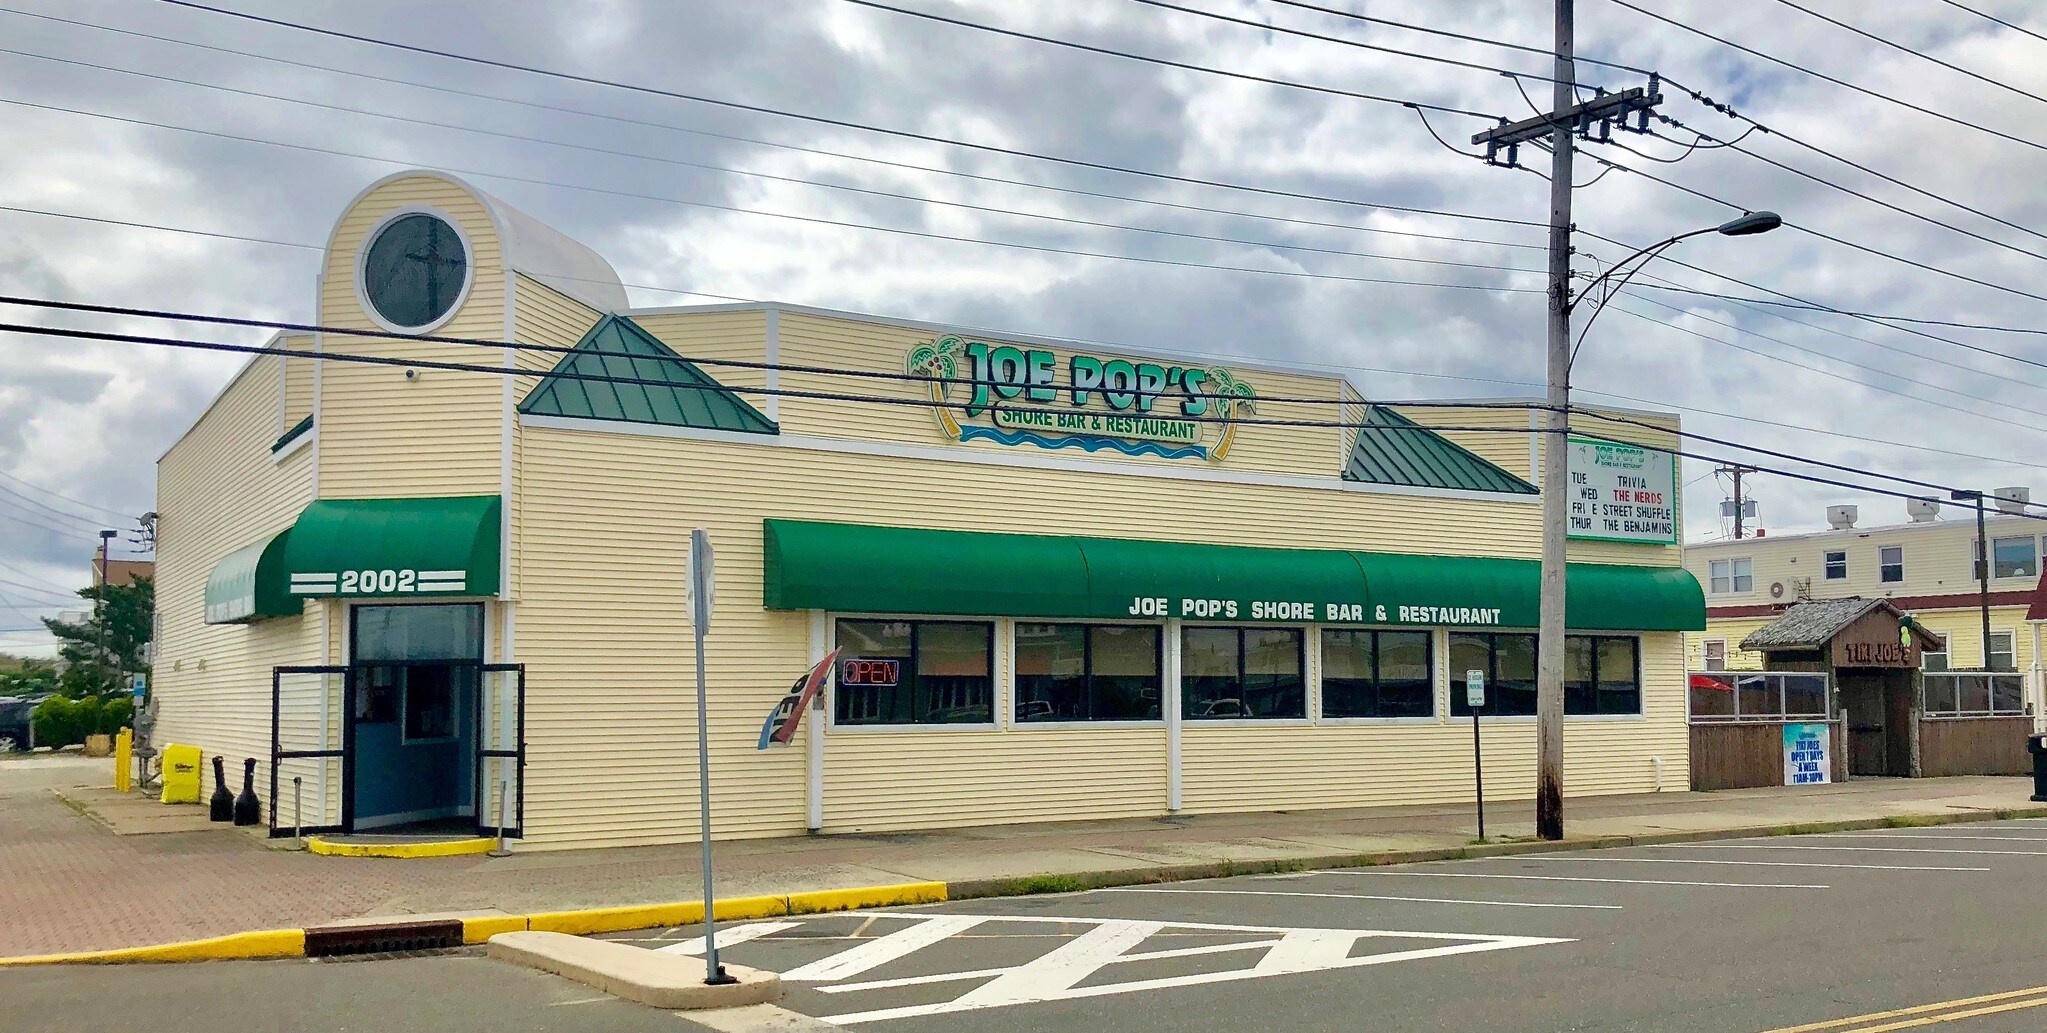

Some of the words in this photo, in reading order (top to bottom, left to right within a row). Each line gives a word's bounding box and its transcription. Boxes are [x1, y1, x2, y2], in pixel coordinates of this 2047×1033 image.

[964, 342, 1057, 418] JOE
[1070, 355, 1208, 416] POP'S
[1002, 408, 1053, 426] SHORE
[1057, 413, 1086, 430] BAR
[1091, 415, 1102, 431] &
[1106, 415, 1196, 439] RESTAURANT
[1594, 445, 1613, 464] JOE
[1615, 447, 1645, 463] POP'S
[1571, 471, 1587, 484] TUE
[1617, 475, 1647, 489] TRIVIA
[1580, 487, 1598, 500] WED
[1613, 489, 1630, 502] THE
[1634, 491, 1662, 505] NERDS
[1572, 502, 1586, 514] FRI
[1592, 503, 1598, 515] E
[1603, 504, 1633, 517] STREET
[1636, 506, 1671, 520] SHUFFLE
[1570, 516, 1592, 530] THUR
[1603, 519, 1619, 531] THE
[1624, 520, 1672, 535] BENJAMINS
[341, 569, 416, 593] 2002
[1129, 597, 1168, 616] JOE
[1181, 599, 1238, 618] POP'S
[1251, 601, 1315, 620] SHORE
[1326, 603, 1363, 621] BAR
[1375, 604, 1387, 621] &
[1399, 605, 1501, 624] RESTAURANT
[1846, 642, 1873, 662] TIKI
[845, 661, 897, 683] OPEN
[769, 662, 820, 743] PEN
[1791, 751, 1805, 762] OPEN
[1809, 750, 1824, 761] DAYS
[1798, 762, 1803, 772] A
[1803, 761, 1818, 771] WEEK
